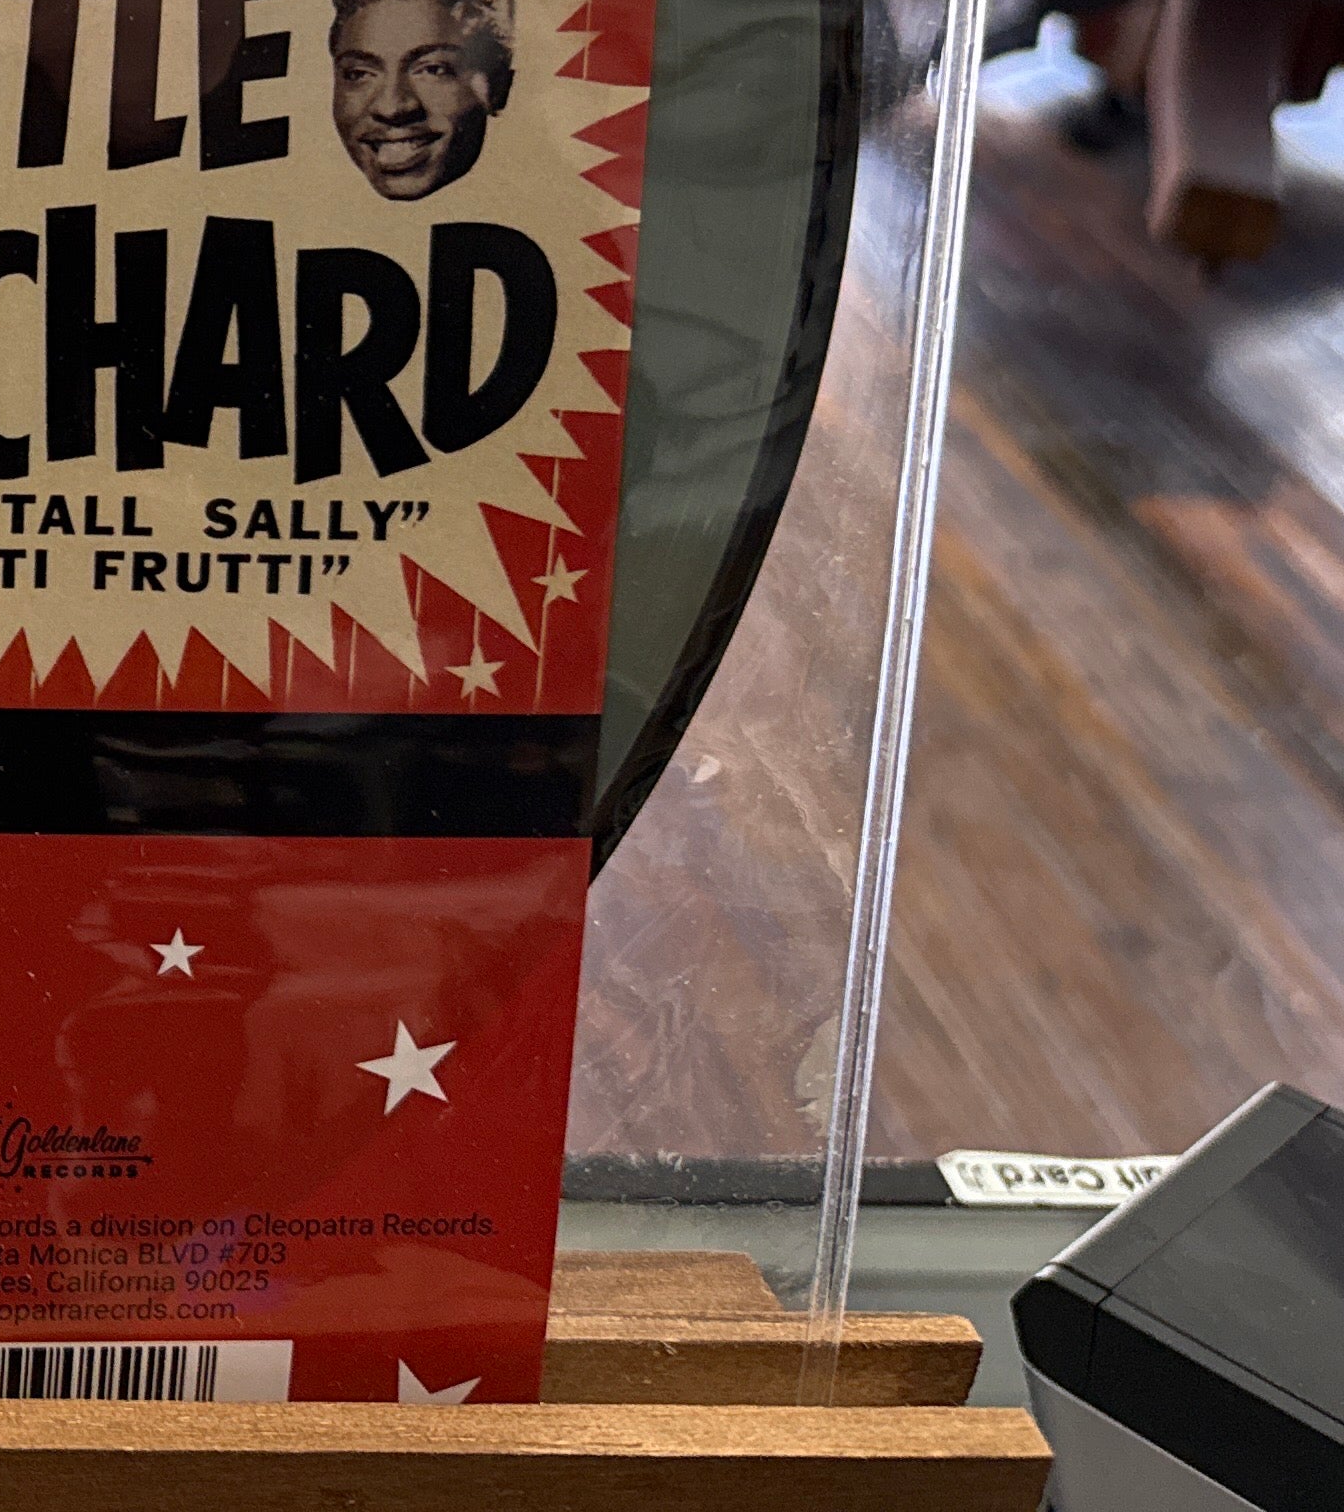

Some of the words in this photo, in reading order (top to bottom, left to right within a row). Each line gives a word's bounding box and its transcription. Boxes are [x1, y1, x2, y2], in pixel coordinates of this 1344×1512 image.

[1, 494, 154, 537] TALL
[23, 1164, 140, 1179] RECORDS
[993, 1161, 1105, 1195] Card
[66, 1219, 82, 1237] a
[90, 1212, 193, 1237] division
[202, 1219, 236, 1237] on
[244, 1213, 374, 1241] Cleopatra
[382, 1211, 499, 1237] Records.
[28, 1243, 129, 1267] Monica
[138, 1242, 209, 1266] BLVD
[219, 1242, 288, 1266] #703
[47, 1270, 176, 1295] California
[185, 1269, 270, 1293] 90025
